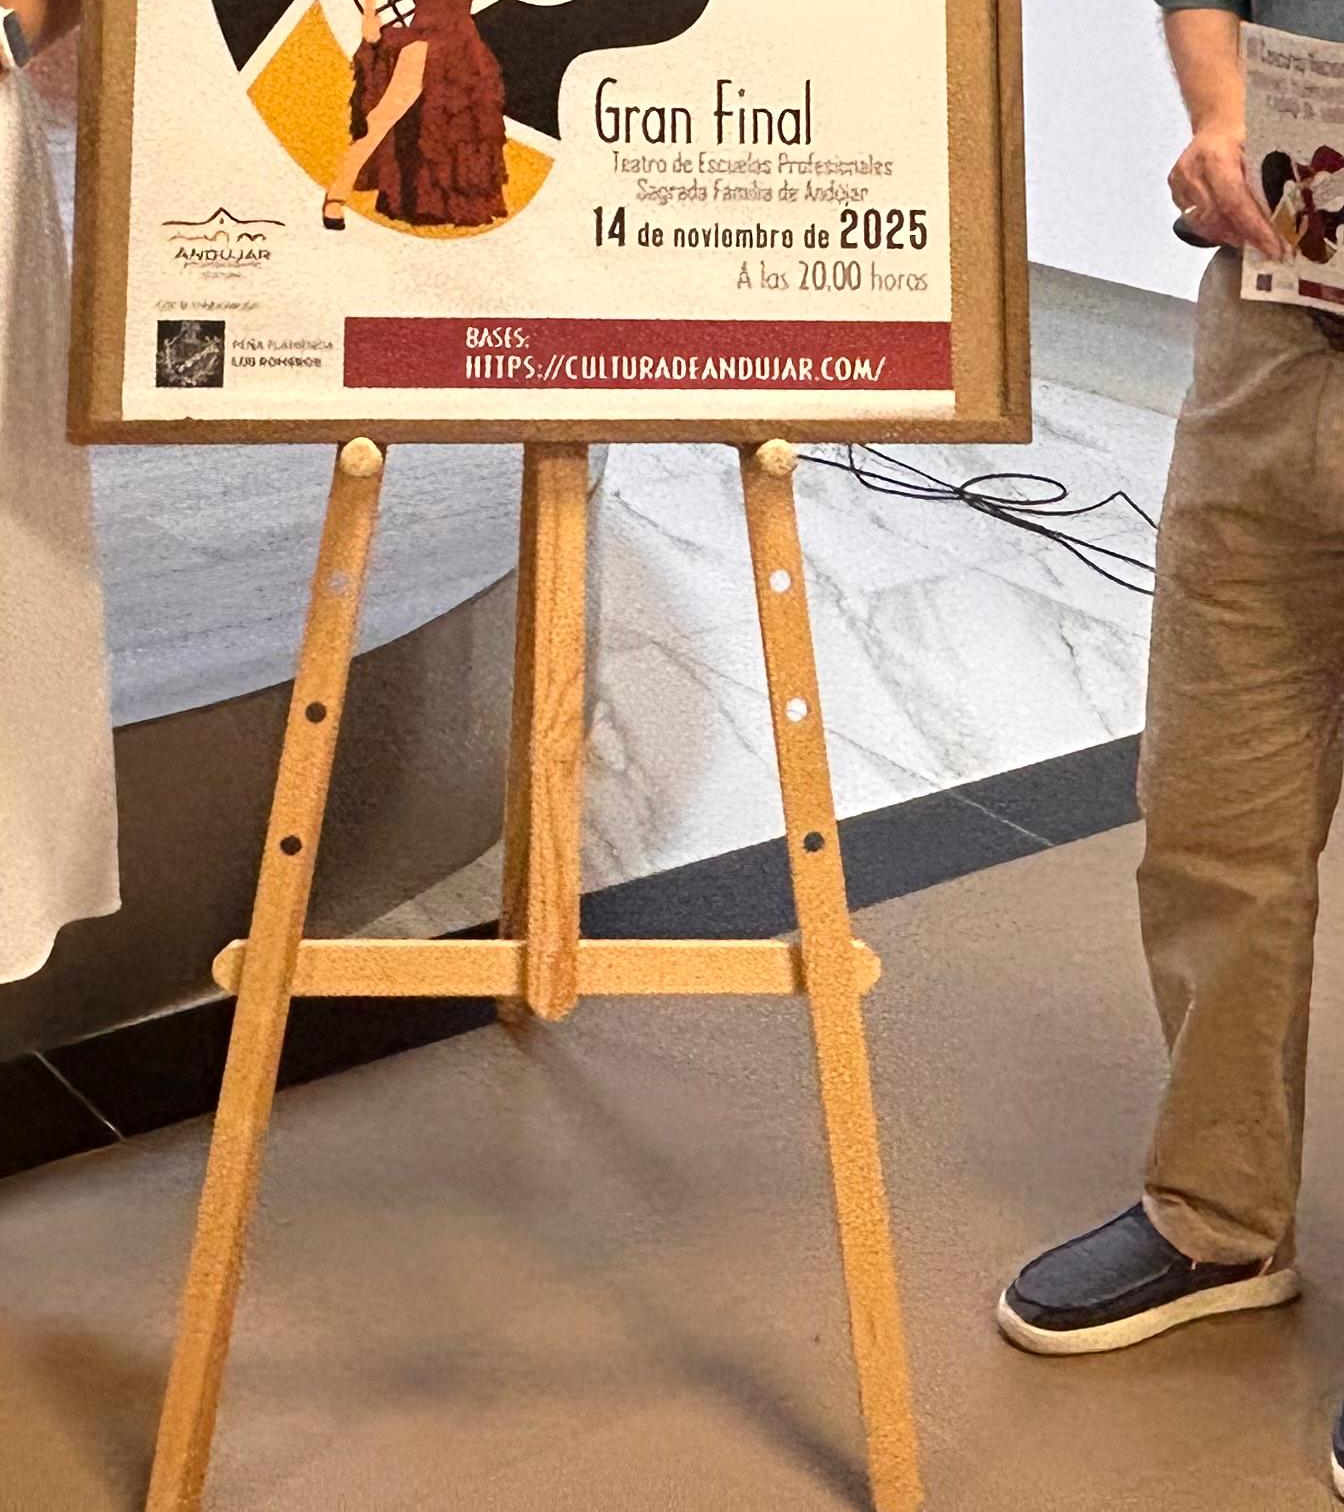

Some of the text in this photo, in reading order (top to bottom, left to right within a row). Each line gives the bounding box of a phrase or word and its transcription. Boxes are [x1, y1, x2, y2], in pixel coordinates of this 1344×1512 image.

[594, 76, 812, 146] Gran Final
[613, 151, 667, 174] Teatro
[672, 152, 693, 174] de
[699, 151, 772, 176] Escuelas
[778, 179, 798, 202] de
[593, 206, 928, 251] 14 de noviembre de 2025
[737, 260, 929, 292] A las 20.00 horas
[466, 326, 530, 349] BASES:
[465, 354, 887, 382] HTTPS://CULTURADEANDUJAR.COM/
